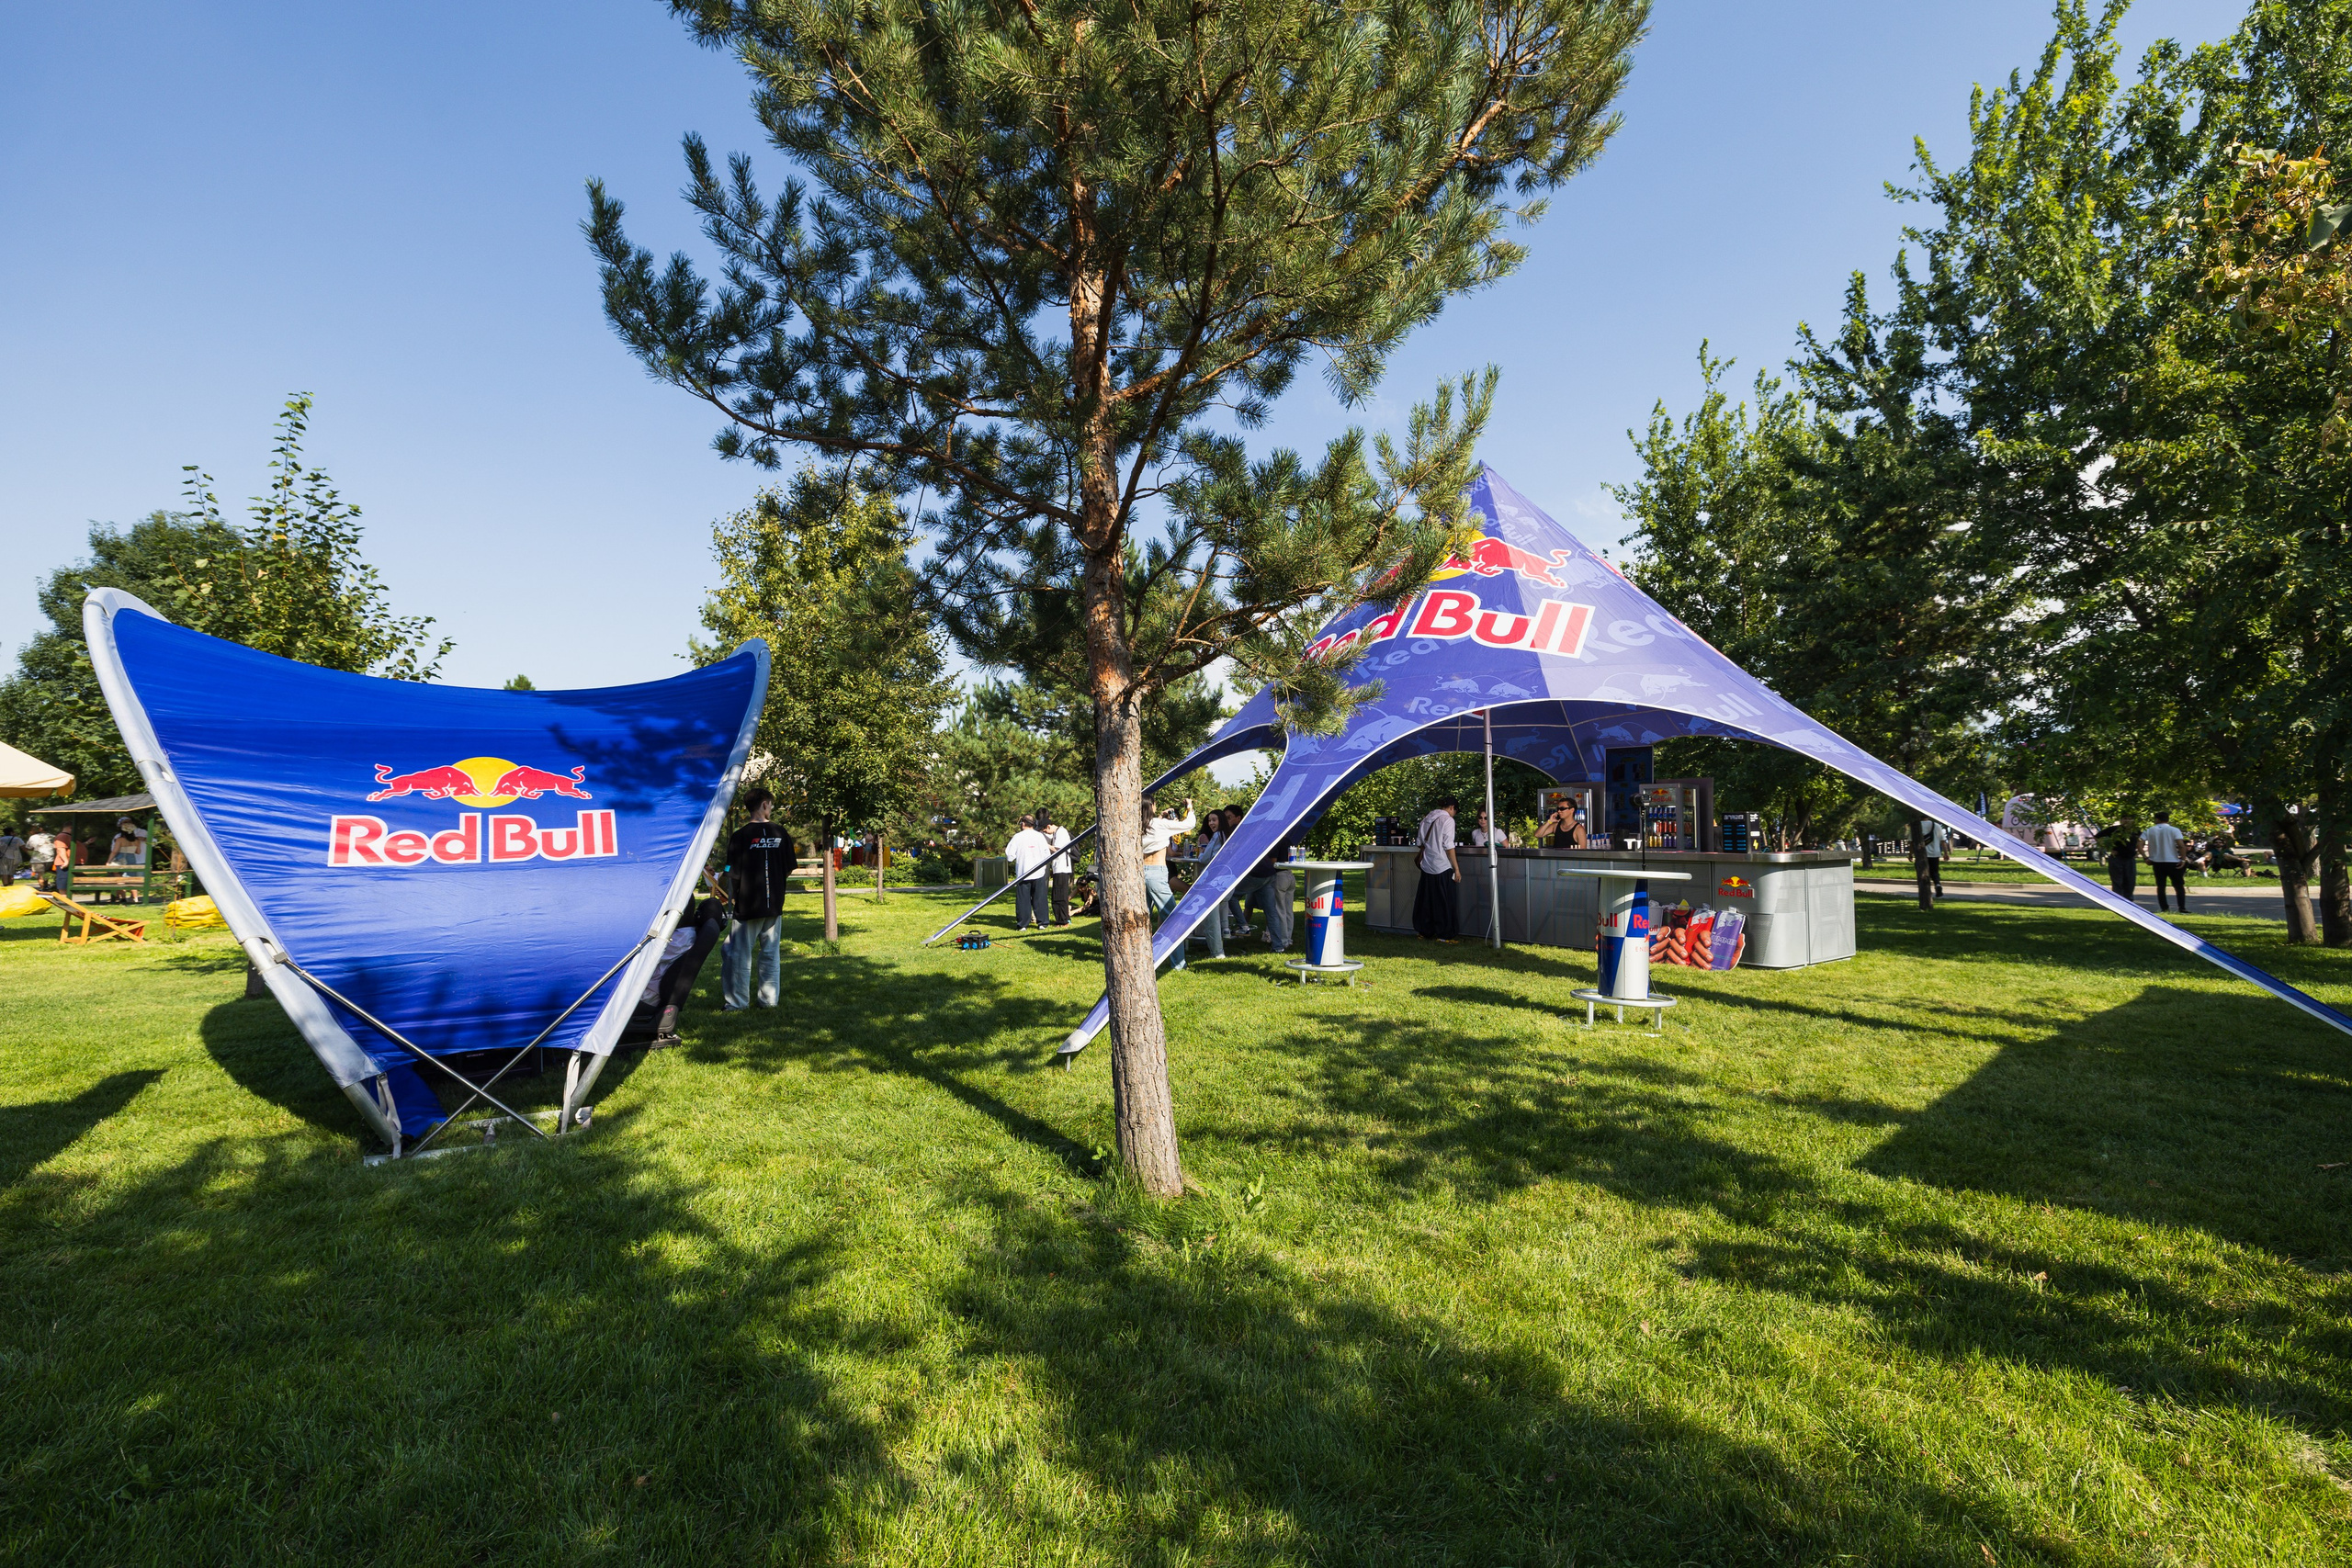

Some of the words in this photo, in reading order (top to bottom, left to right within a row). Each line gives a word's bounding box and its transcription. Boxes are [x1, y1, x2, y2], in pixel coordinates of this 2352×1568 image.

[1409, 590, 1594, 658] Bull
[1672, 692, 1764, 722] ull
[331, 814, 480, 865] Red
[491, 810, 616, 862] Bull
[1718, 887, 1736, 897] Red
[1736, 888, 1753, 898] Bull
[1305, 897, 1325, 909] Bull
[1334, 897, 1344, 909] Re
[1633, 913, 1650, 929] Re
